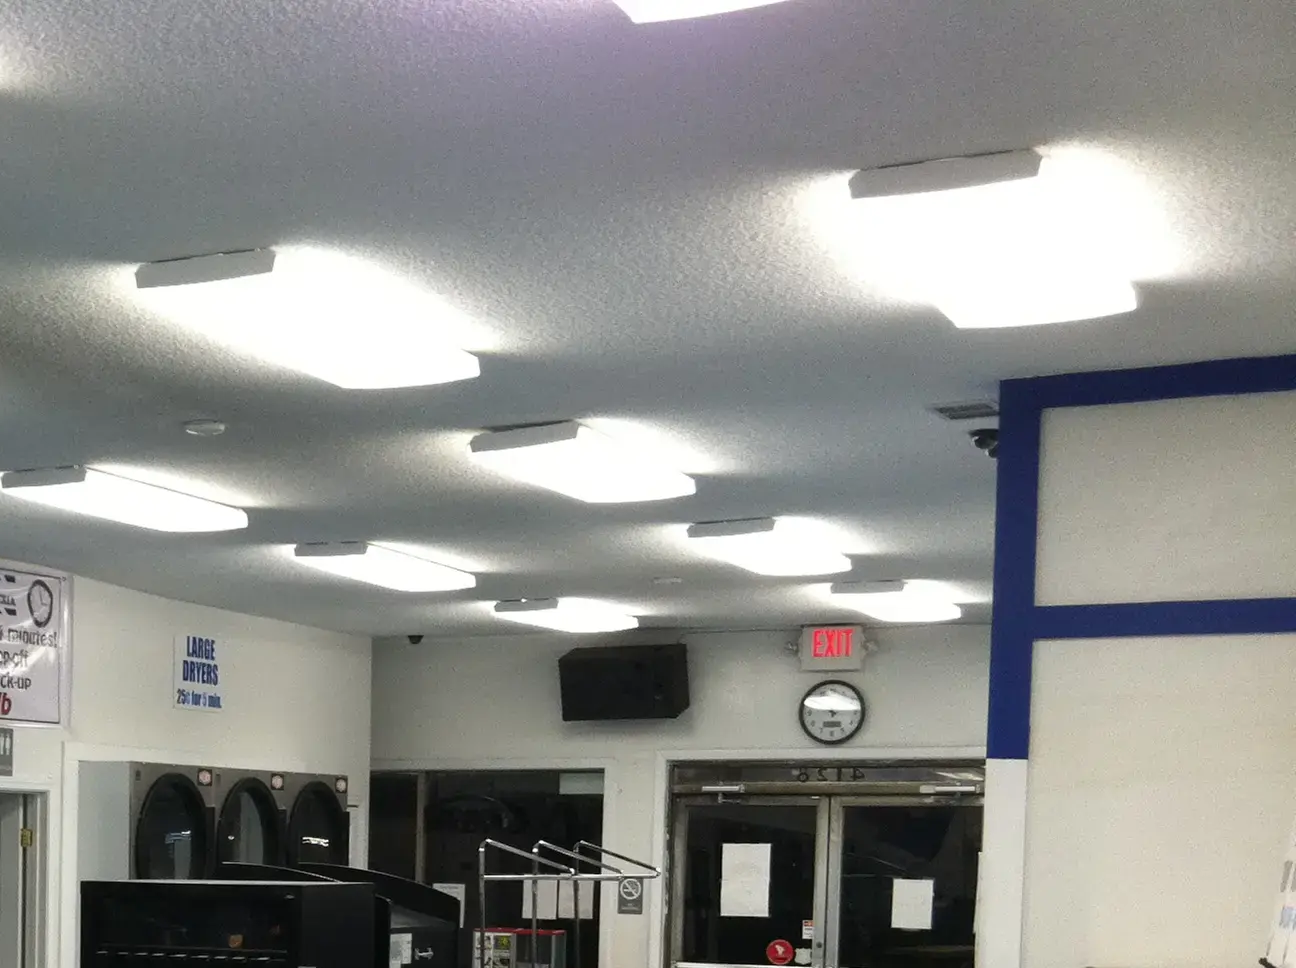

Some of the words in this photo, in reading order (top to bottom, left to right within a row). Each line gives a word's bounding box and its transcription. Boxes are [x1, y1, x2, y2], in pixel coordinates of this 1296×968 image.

[7, 629, 58, 648] minutes!
[186, 635, 216, 661] LARGE
[811, 628, 854, 658] EXIT
[182, 660, 219, 687] DRYERS
